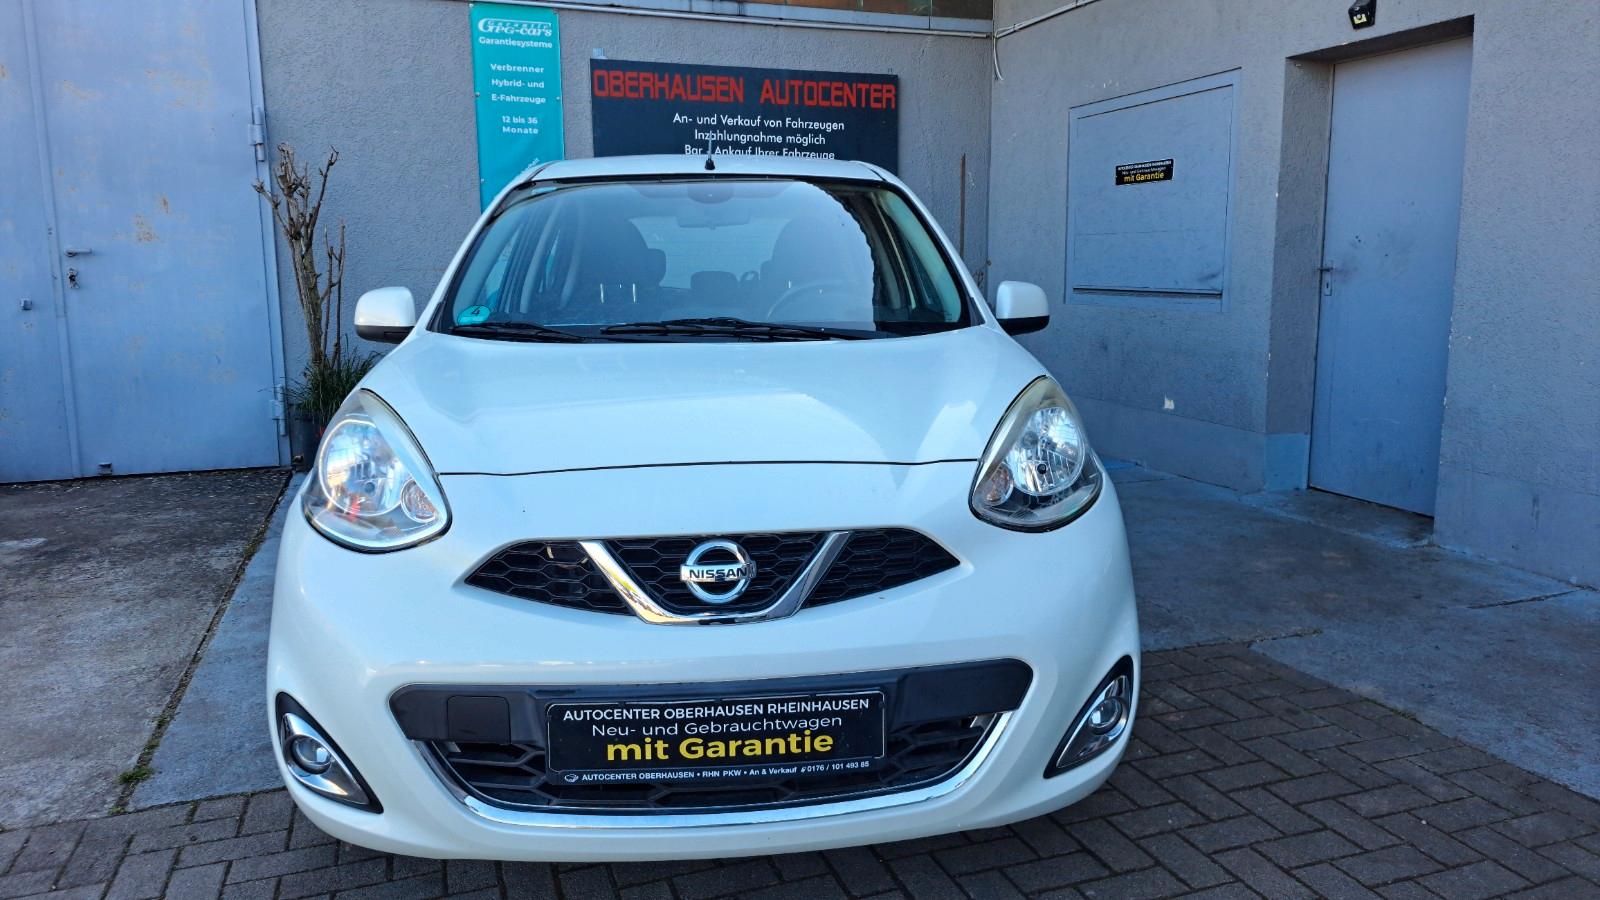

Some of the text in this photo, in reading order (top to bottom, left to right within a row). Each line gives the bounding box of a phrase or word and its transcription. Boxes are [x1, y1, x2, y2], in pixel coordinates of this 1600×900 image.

[479, 36, 553, 49] Garantiesysteme
[490, 63, 544, 74] Verbrenner
[491, 78, 545, 89] Hybrid- und
[593, 69, 896, 110] OBERHAUSEN AUTOCENTER
[491, 93, 546, 105] E-Fahrzeuge
[502, 115, 538, 124] 12 bis 36
[673, 112, 845, 132] An- und Verkauf von Fahrzeugen
[502, 126, 539, 135] Monate
[695, 128, 826, 147] Inzahlungnahme möglich
[685, 144, 835, 160] Bar Ankauf Ihrer Fahrzeuge
[1135, 172, 1165, 181] Garantie
[471, 306, 480, 316] 4
[689, 567, 747, 579] NISSAN
[563, 699, 869, 721] AUTOCENTER OBERHAUSEN RHEINHAUSEN
[592, 716, 842, 737] Neu- und Gebrauchtwagen
[607, 729, 834, 761] mit Garantie
[582, 773, 637, 781] AUTOCENTER
[638, 771, 695, 780] OBERHAUSEN
[702, 770, 720, 778] RHN
[722, 769, 742, 777] PKW
[749, 768, 760, 776] An
[768, 766, 797, 775] Verkauf
[807, 764, 825, 772] 0176
